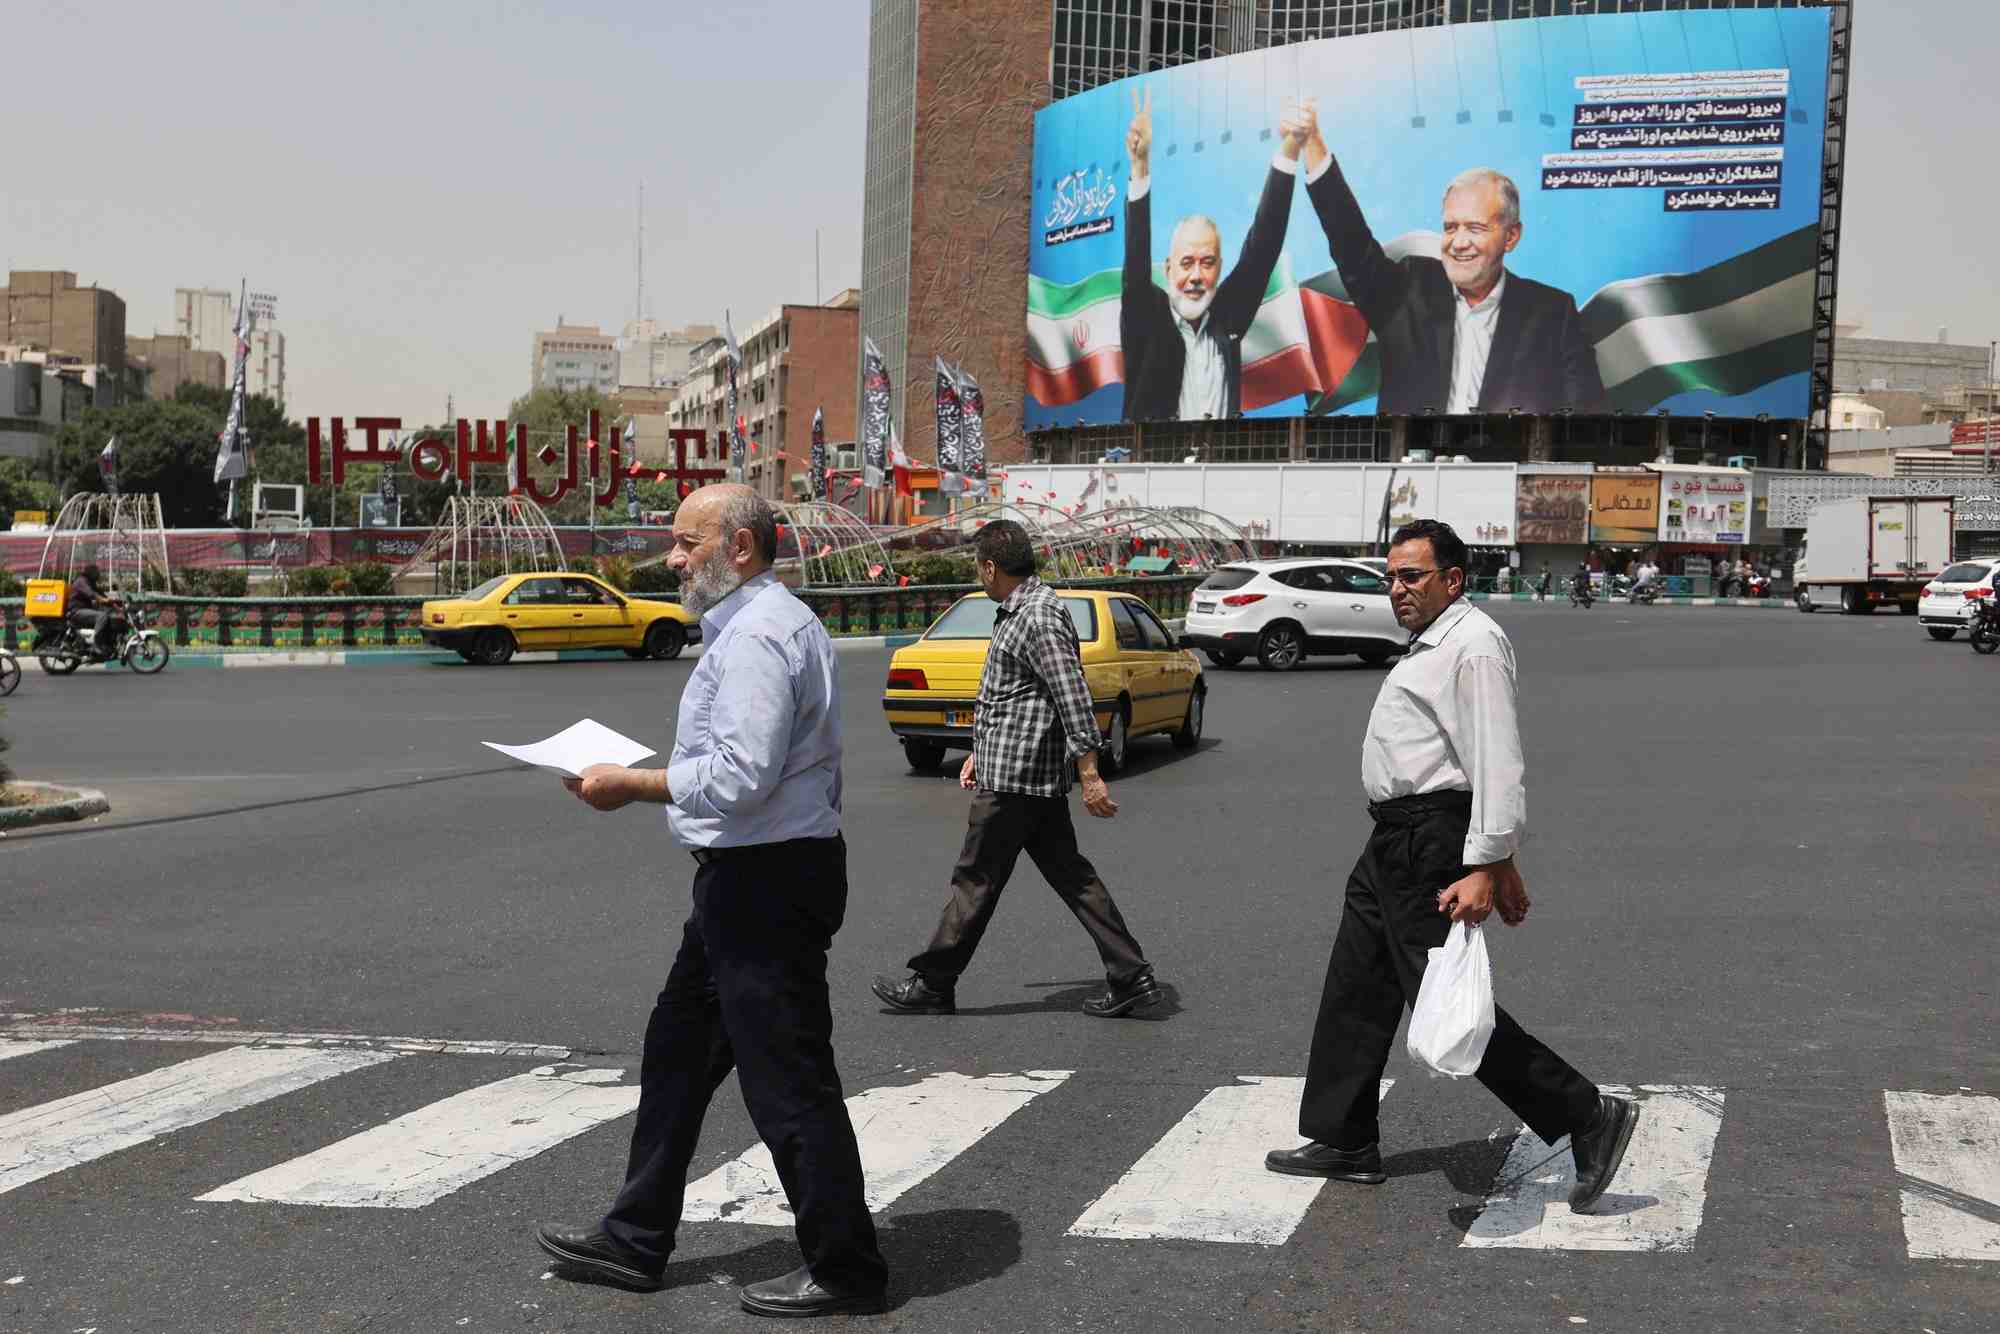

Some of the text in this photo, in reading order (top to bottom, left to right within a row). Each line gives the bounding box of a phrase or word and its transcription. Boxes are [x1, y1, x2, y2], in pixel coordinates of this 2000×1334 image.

[1577, 106, 1609, 123] امروز
[1619, 107, 1645, 123] بردم
[1647, 104, 1664, 120] بالا
[1685, 100, 1713, 122] فاتح
[1714, 103, 1748, 115] دست
[1747, 103, 1782, 118] دیروز
[1574, 130, 1598, 148] کنم
[1598, 128, 1640, 148] تشییع
[1718, 129, 1742, 143] روی
[1742, 128, 1755, 142] بر
[1755, 124, 1780, 141] باید
[1545, 171, 1570, 188] خود
[1570, 170, 1608, 187] بزدلانه
[1608, 167, 1638, 187] اقدام
[1659, 167, 1716, 185] تروریست
[1716, 166, 1778, 184] اشغالگران
[1668, 190, 1776, 209] پشیمان خواهد کرد
